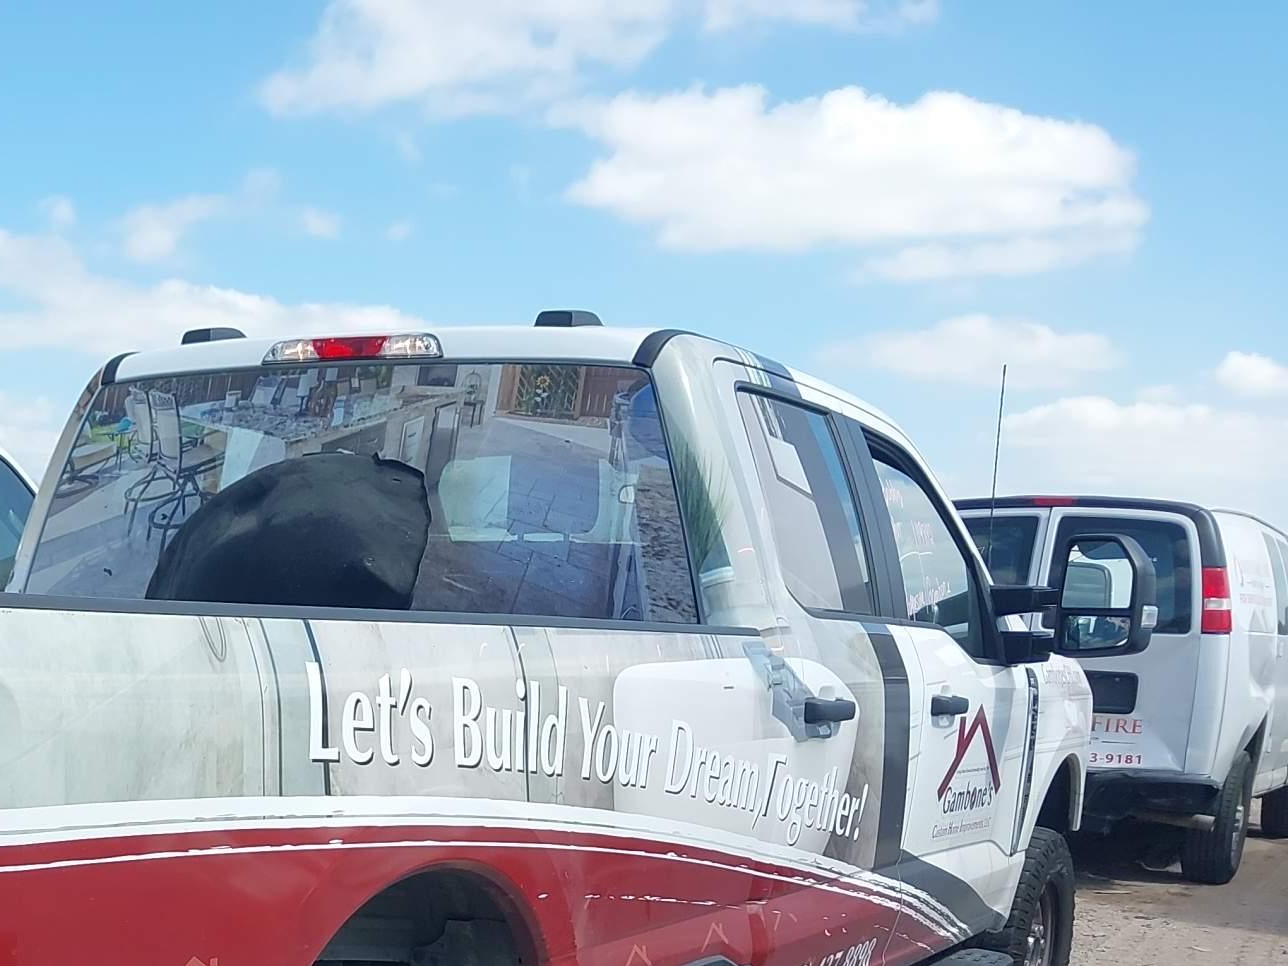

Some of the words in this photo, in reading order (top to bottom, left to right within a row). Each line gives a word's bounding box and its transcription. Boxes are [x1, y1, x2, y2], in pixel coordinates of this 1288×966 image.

[304, 661, 435, 767] Let's
[451, 676, 569, 778] Build
[578, 696, 659, 785] Your
[664, 719, 763, 831] Dream,
[761, 752, 869, 846] Together!
[942, 780, 993, 814] Gambone's
